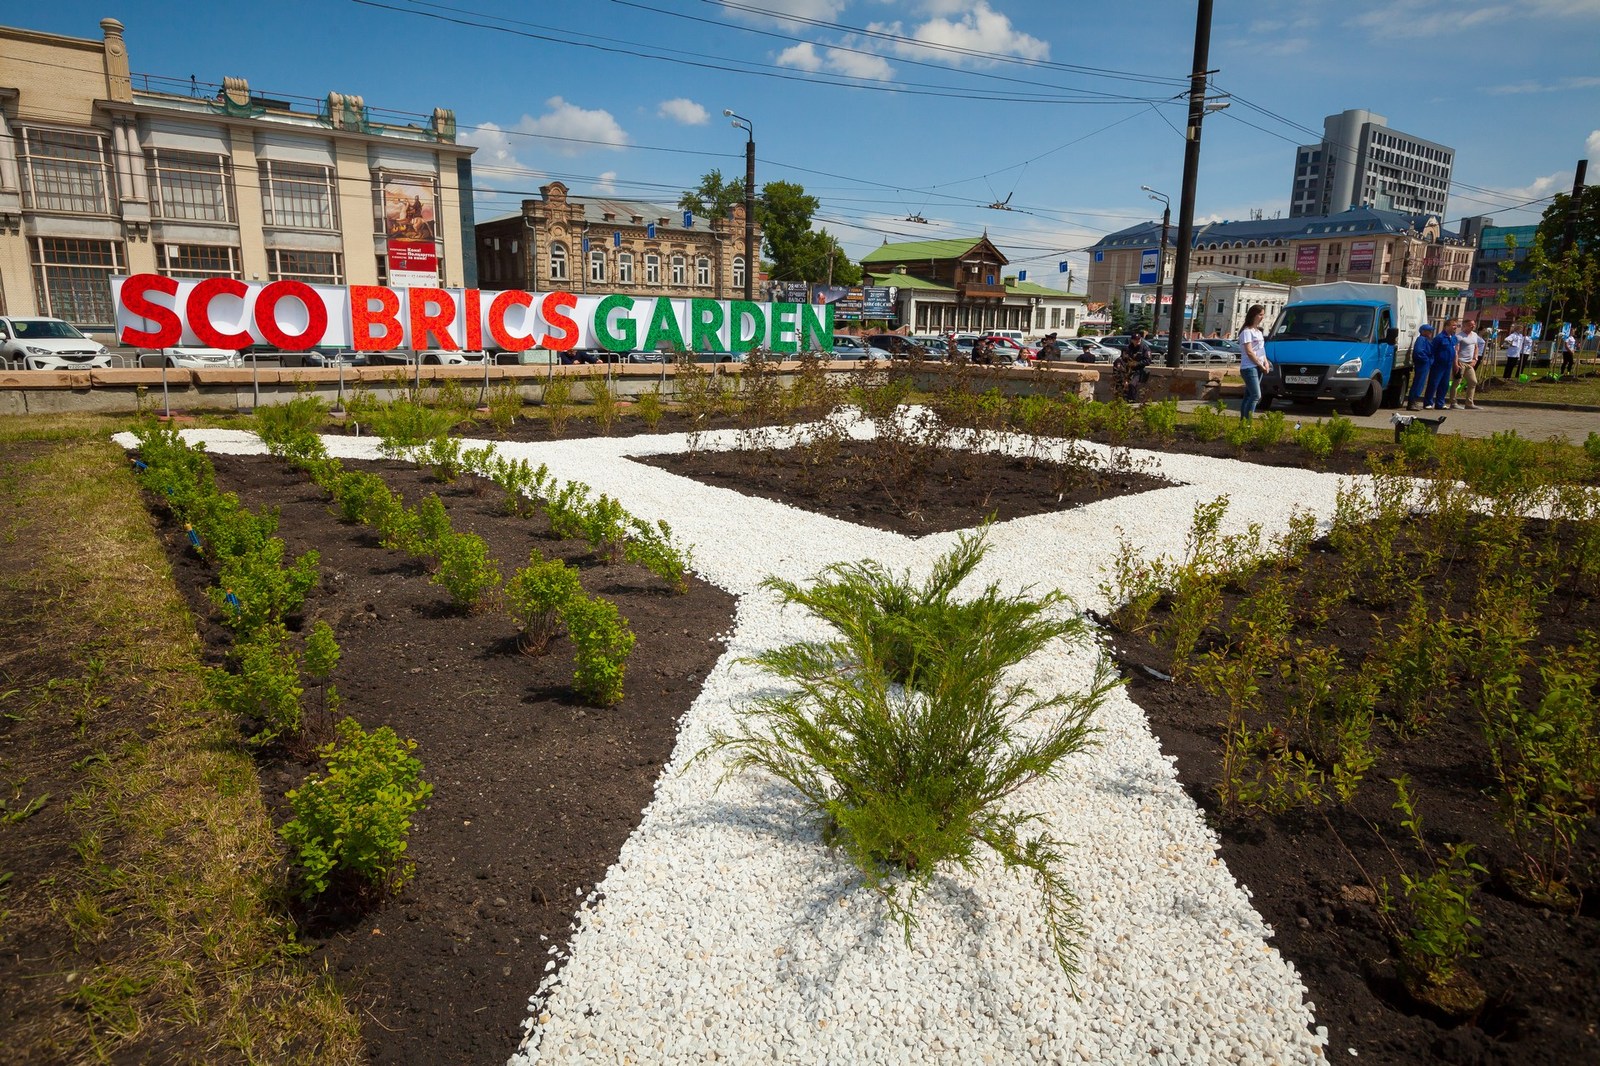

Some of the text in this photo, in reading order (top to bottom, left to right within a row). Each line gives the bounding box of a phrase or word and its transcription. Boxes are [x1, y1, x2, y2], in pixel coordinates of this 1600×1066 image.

[122, 274, 835, 353] SCO BRICS GARDEN
